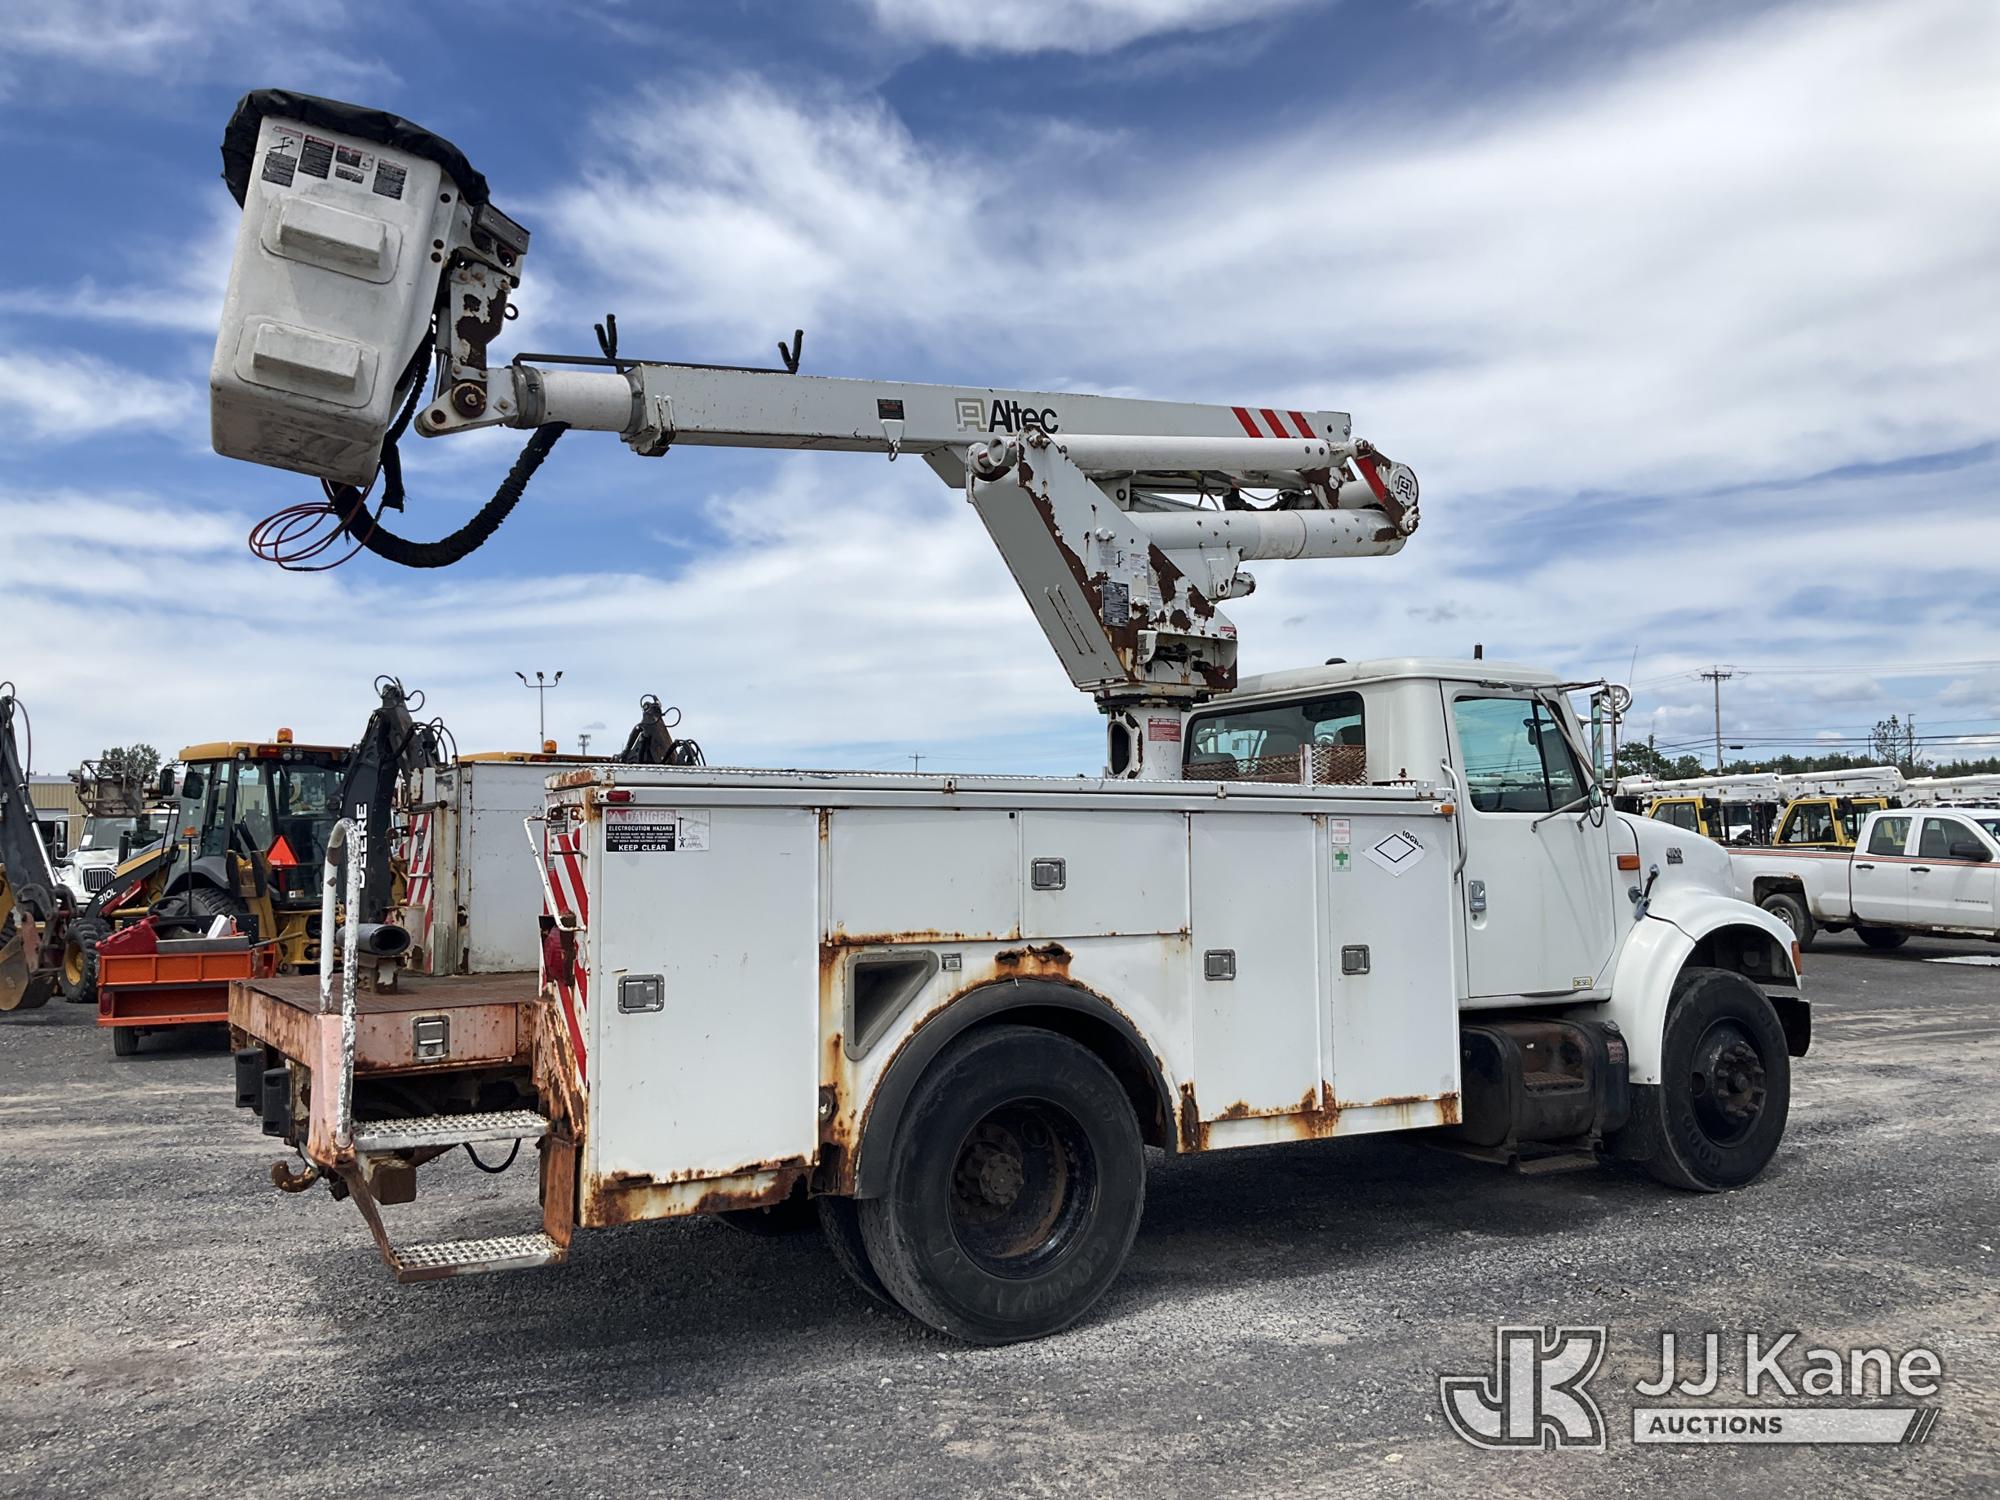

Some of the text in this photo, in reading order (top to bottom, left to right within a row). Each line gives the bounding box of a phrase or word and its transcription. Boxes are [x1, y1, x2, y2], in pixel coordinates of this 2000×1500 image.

[988, 399, 1059, 434] Altec
[625, 810, 674, 823] DANGER
[97, 888, 117, 905] 310L
